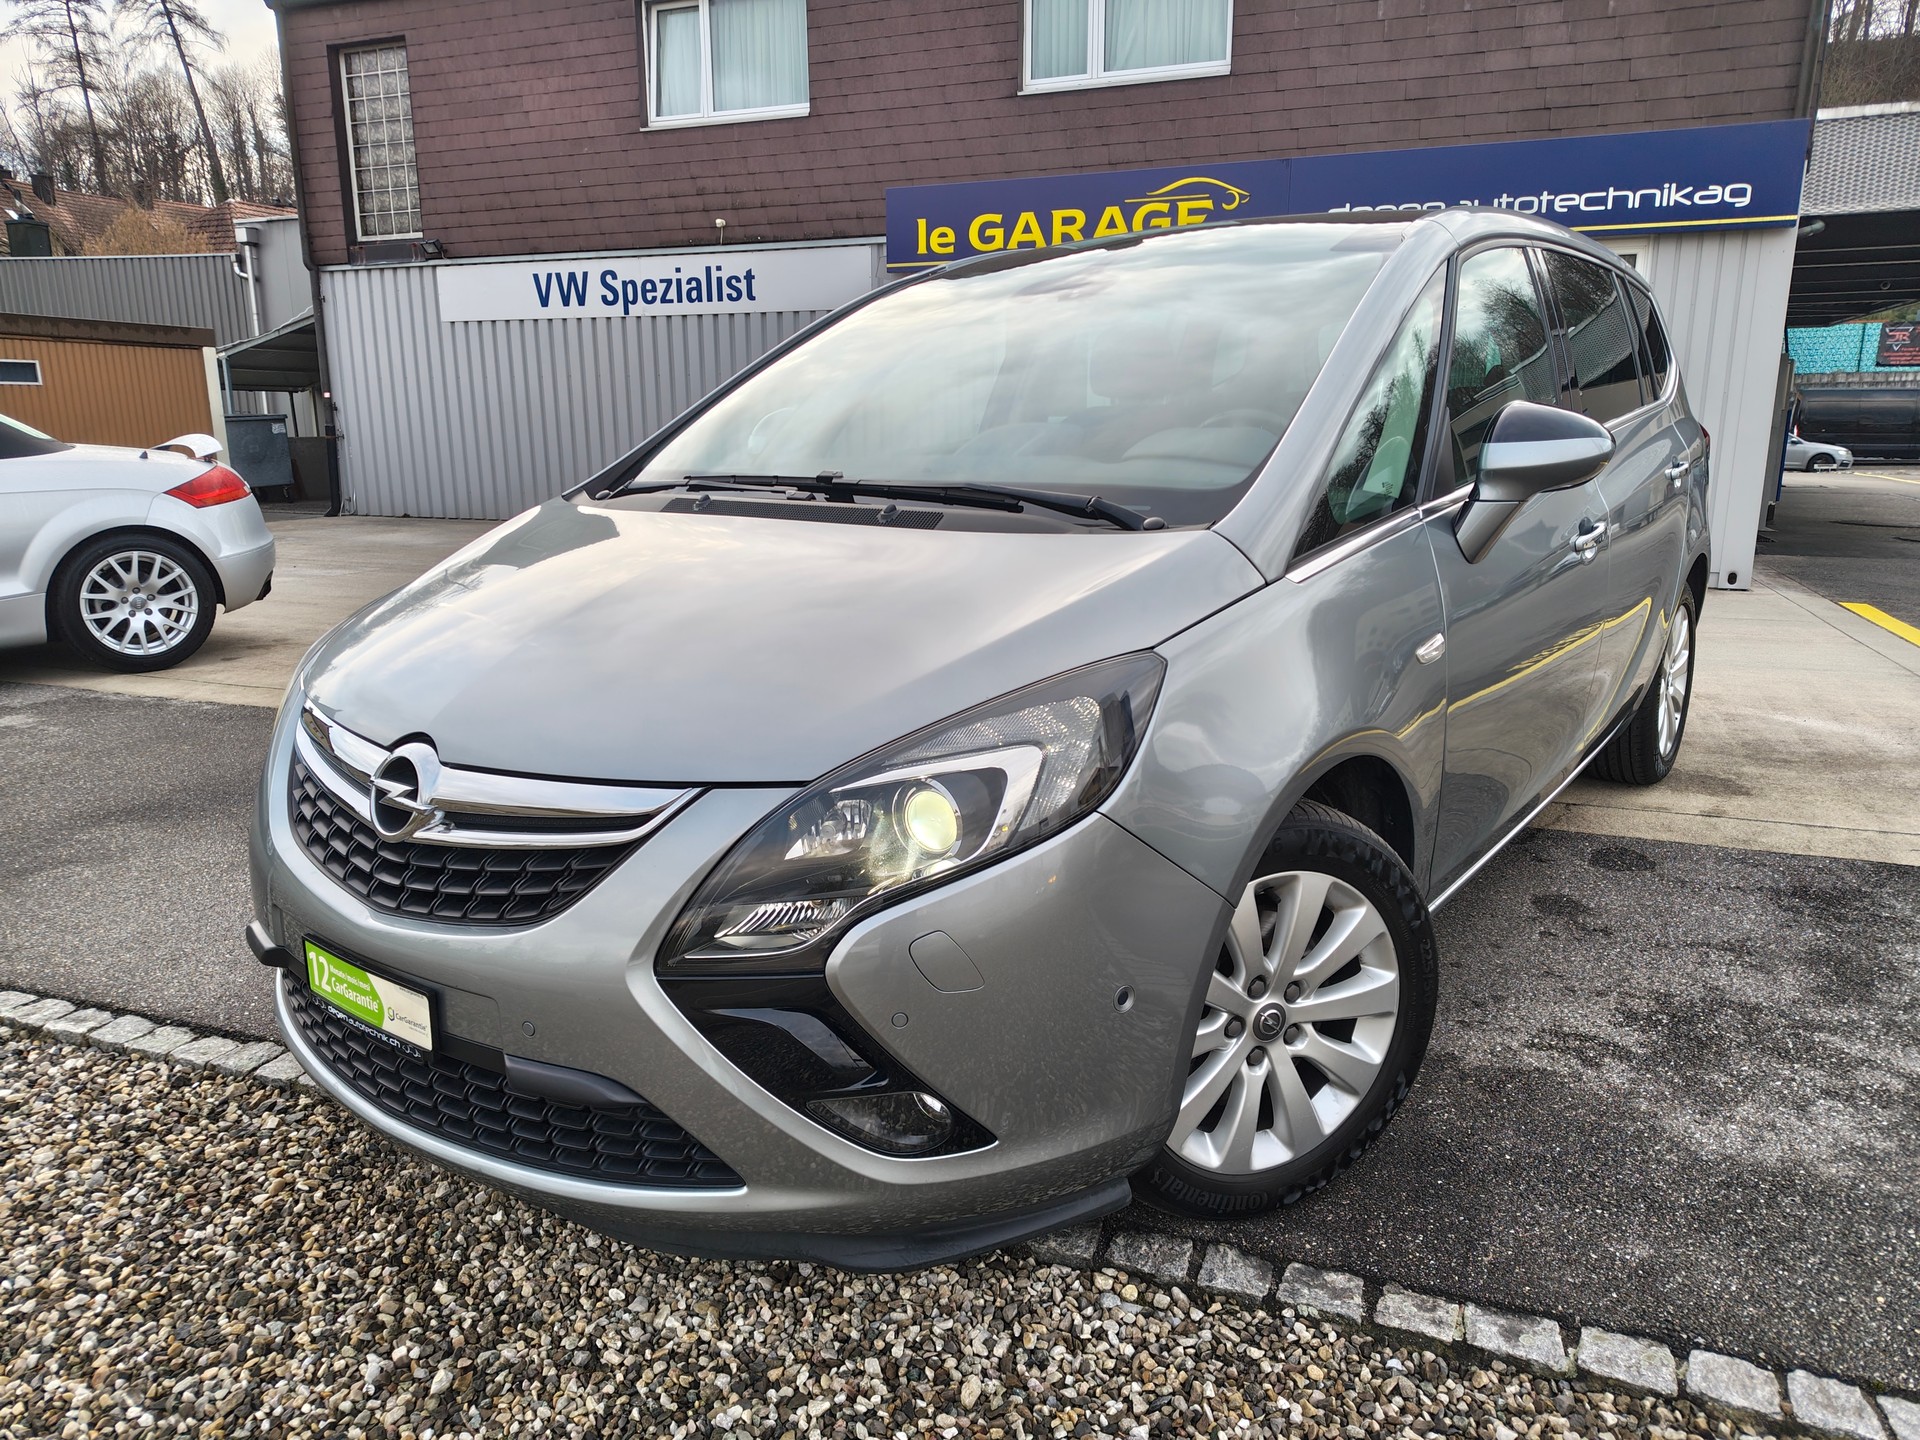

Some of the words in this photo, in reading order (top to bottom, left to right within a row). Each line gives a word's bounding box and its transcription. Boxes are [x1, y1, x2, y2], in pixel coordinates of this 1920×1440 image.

[917, 217, 955, 254] le
[968, 199, 1214, 250] GARAGE
[532, 271, 588, 307] VW
[600, 265, 756, 315] Spezialist
[308, 951, 332, 993] 12
